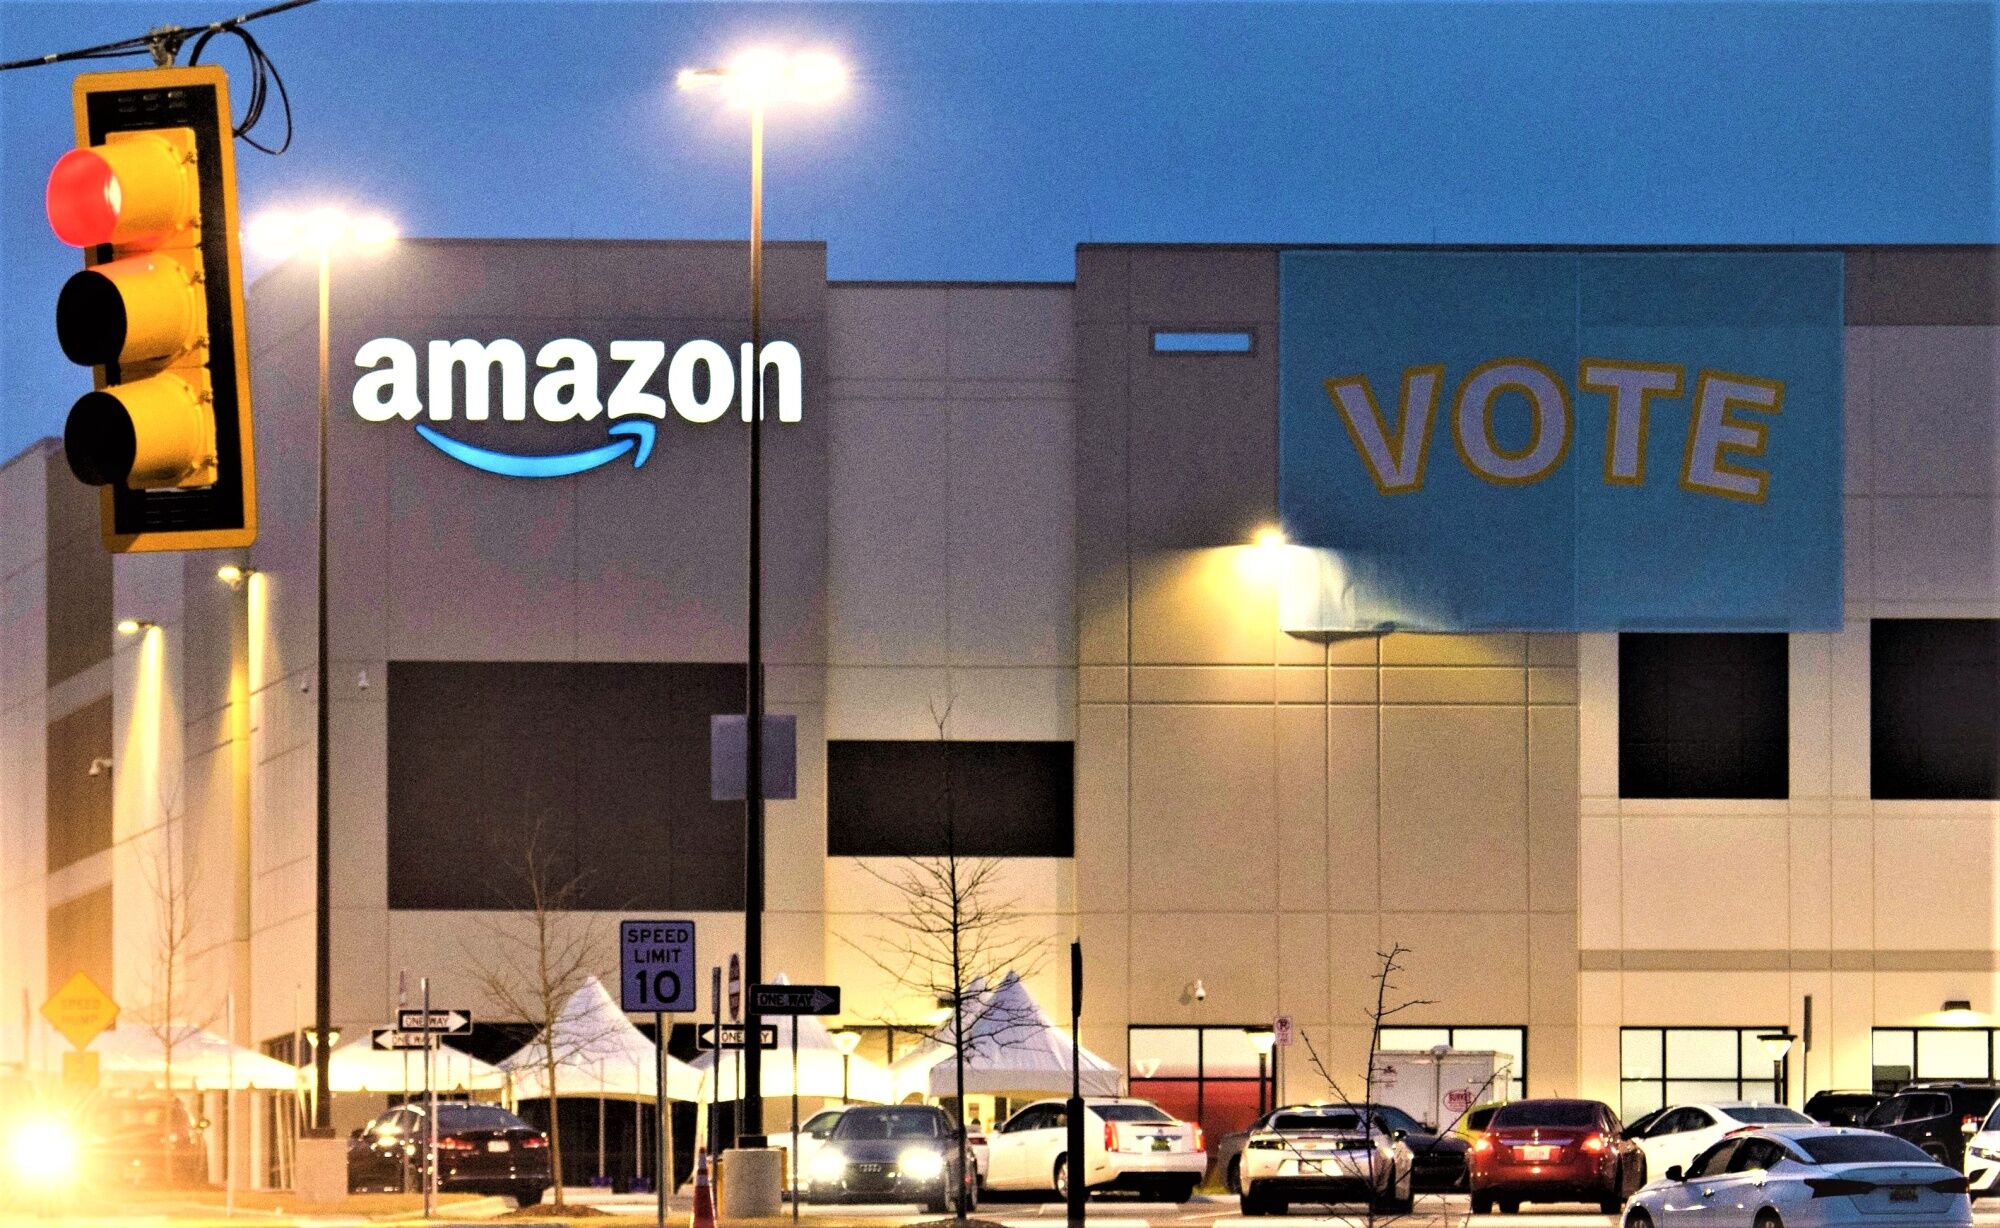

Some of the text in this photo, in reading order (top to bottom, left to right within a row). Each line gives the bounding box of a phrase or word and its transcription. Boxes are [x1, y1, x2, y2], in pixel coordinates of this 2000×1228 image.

[352, 337, 802, 423] amazon
[1323, 356, 1786, 504] VOTE
[627, 929, 689, 943] SPEED
[634, 949, 682, 963] LIMIT
[635, 970, 682, 1004] 10
[61, 998, 100, 1010] SPEED
[758, 993, 813, 1006] ONE WAY
[405, 1016, 448, 1026] ONE WAY
[721, 1031, 743, 1042] ONE
